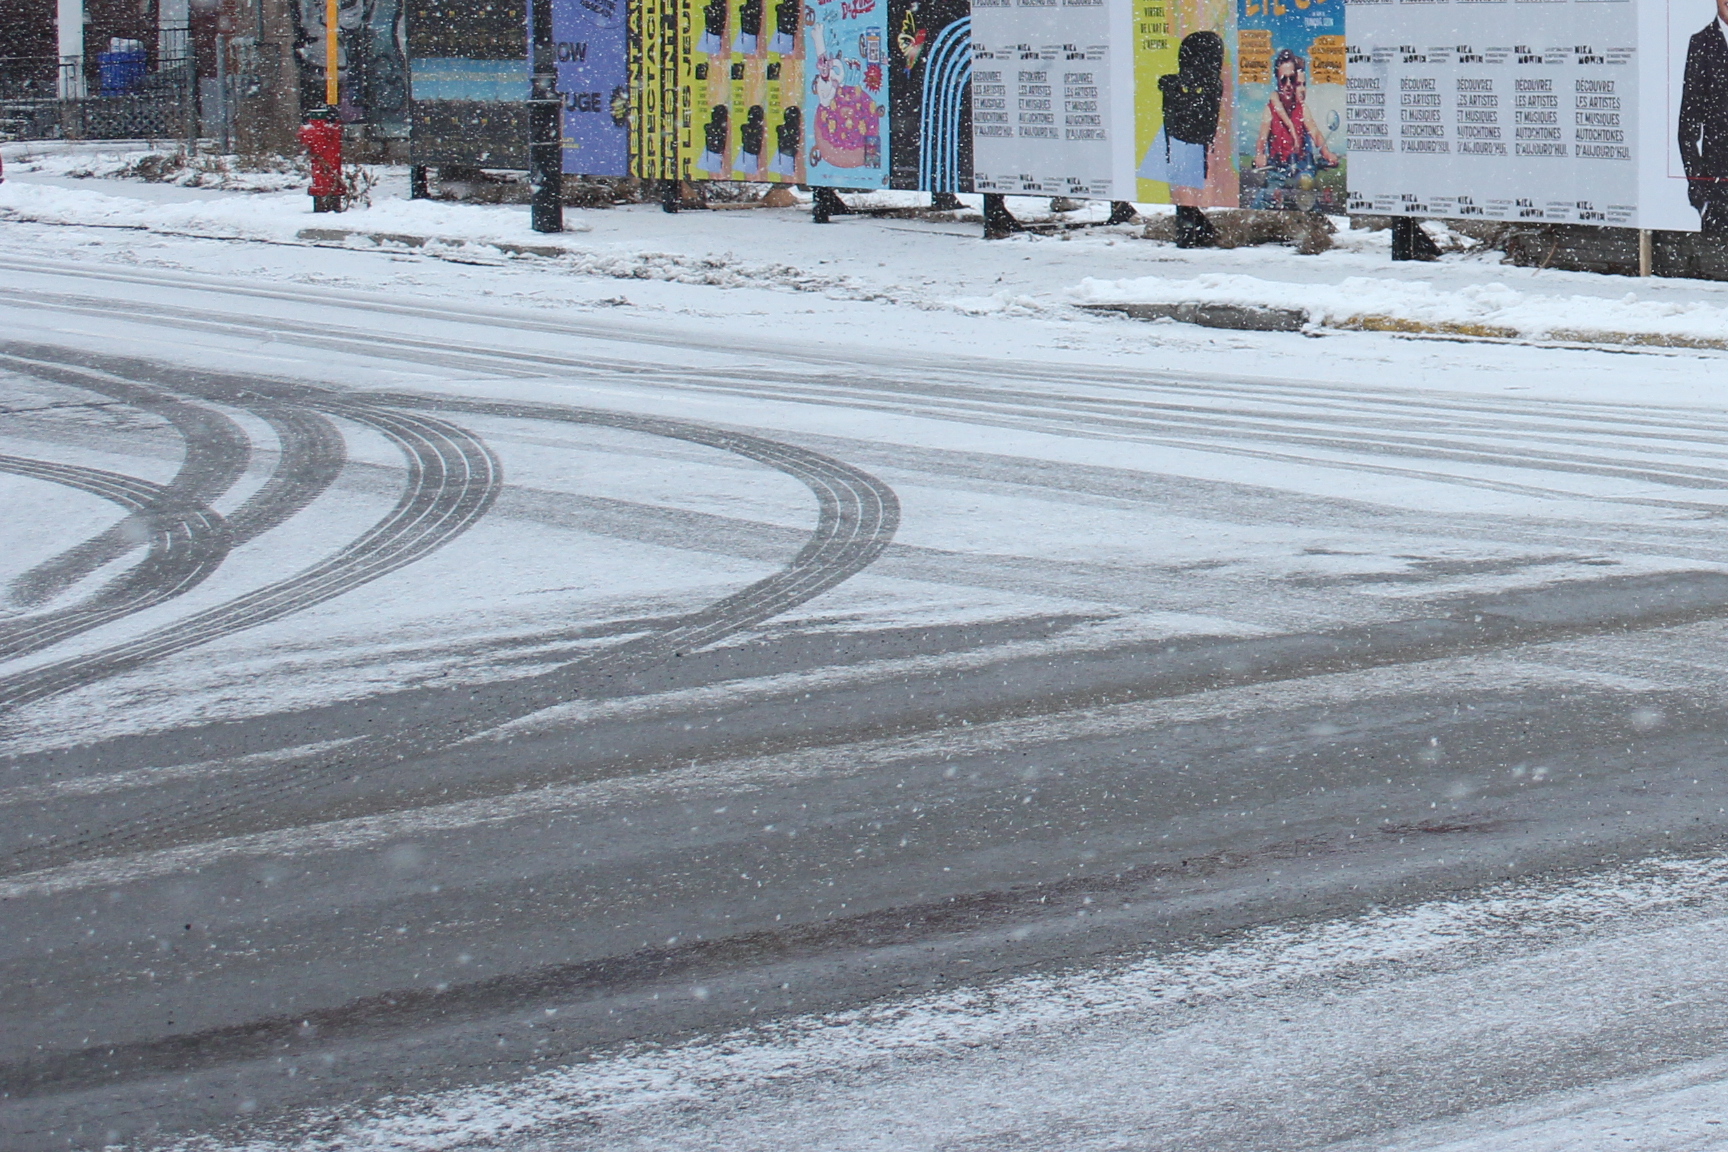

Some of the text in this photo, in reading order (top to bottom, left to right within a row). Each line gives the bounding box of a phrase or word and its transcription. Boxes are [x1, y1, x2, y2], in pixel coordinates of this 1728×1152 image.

[1576, 77, 1614, 92] DÉCOUVREZ
[628, 41, 640, 178] ABSENT
[1576, 96, 1621, 109] LES ARTISTES
[682, 85, 692, 148] LES
[1576, 112, 1583, 124] ET
[1576, 129, 1624, 141] AUTOCHTONES
